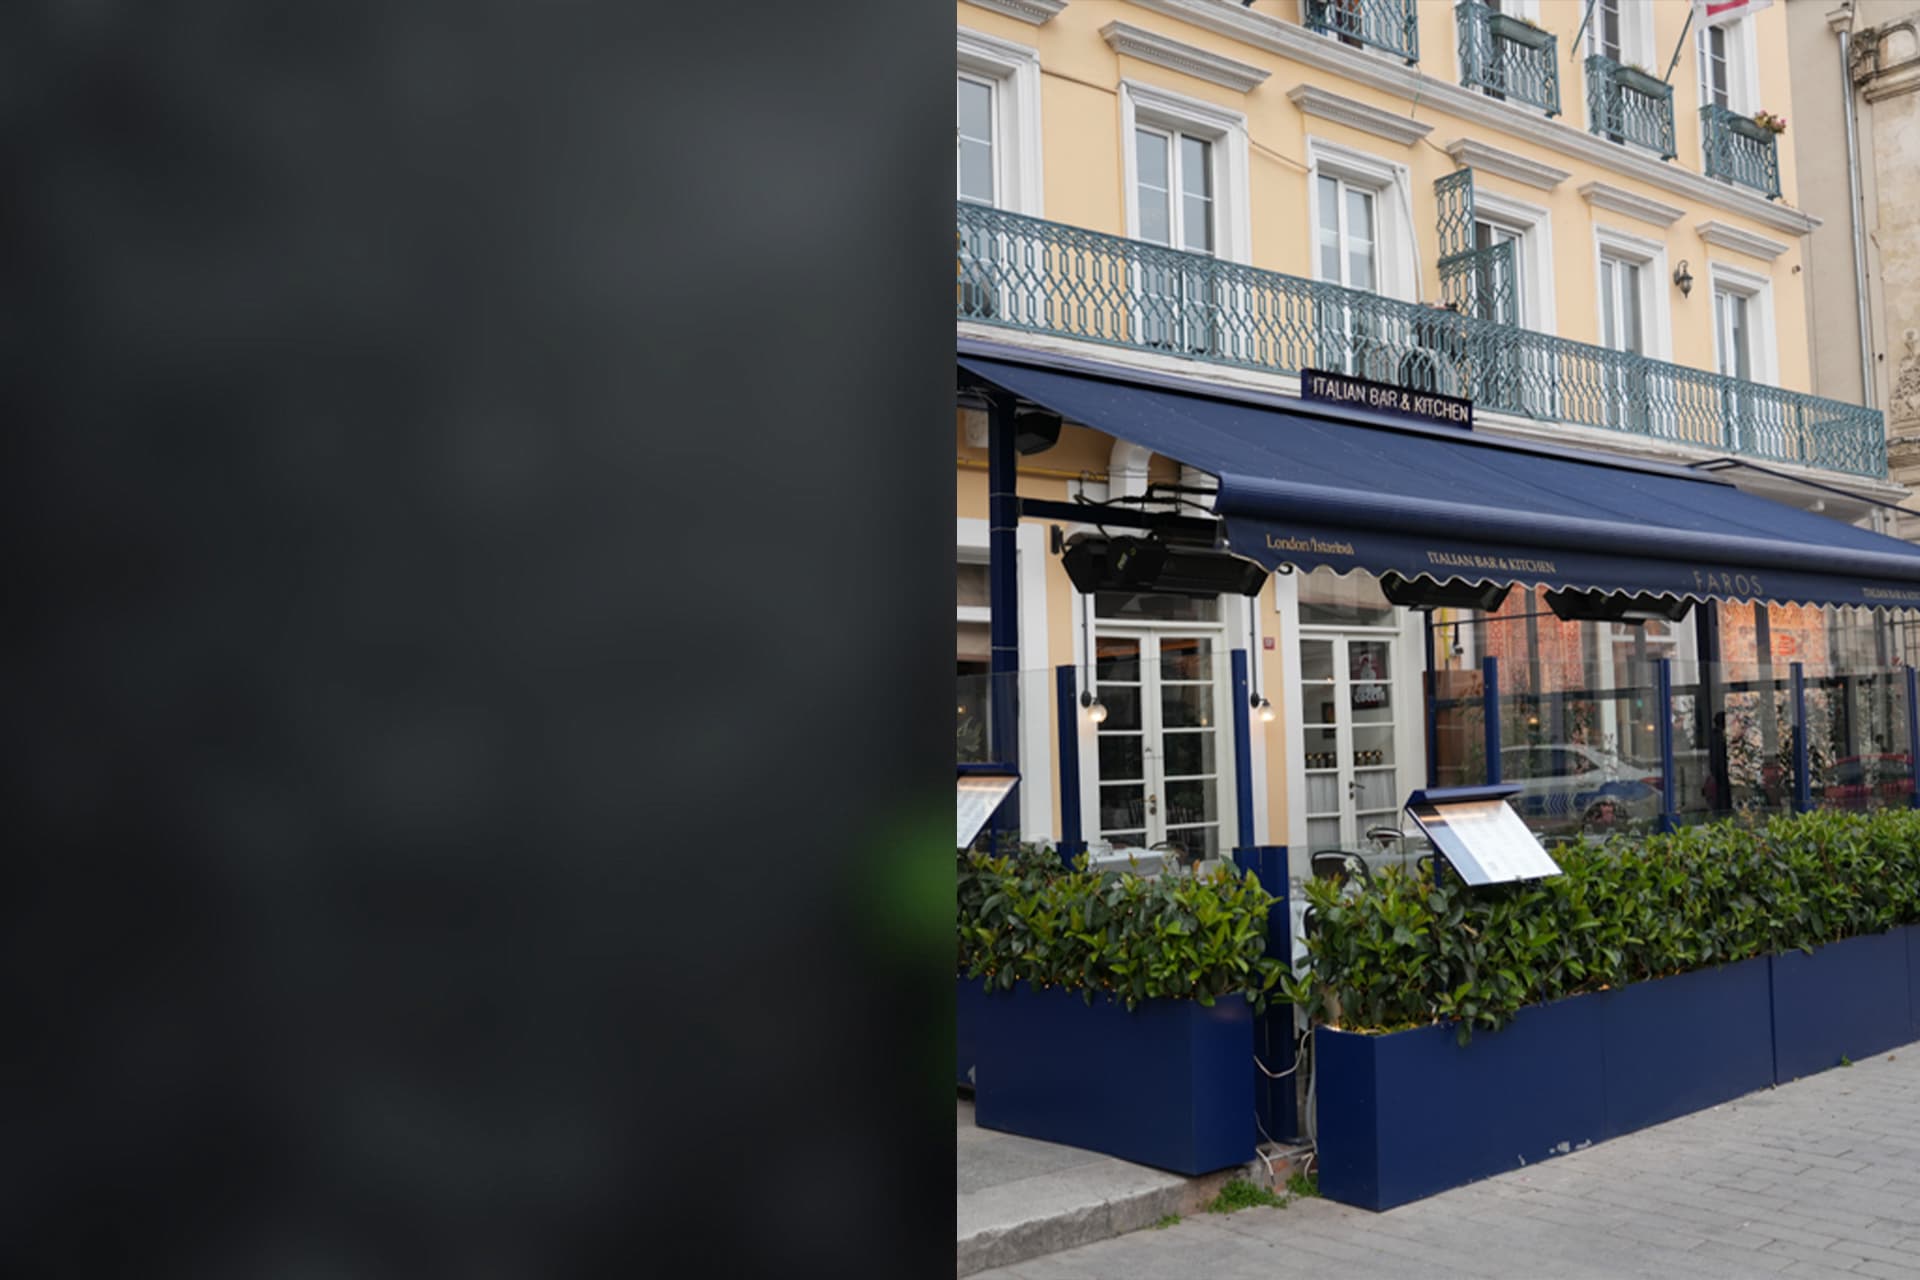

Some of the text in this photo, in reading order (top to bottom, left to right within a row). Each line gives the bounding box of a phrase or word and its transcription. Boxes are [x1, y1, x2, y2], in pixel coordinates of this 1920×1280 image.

[1313, 378, 1468, 422] ITALIAN BAR & KITCHEN
[1427, 551, 1475, 567] ITALIAN
[1474, 555, 1498, 569] BAR
[1508, 558, 1556, 573] KITCHEN
[1693, 570, 1763, 596] FAROS
